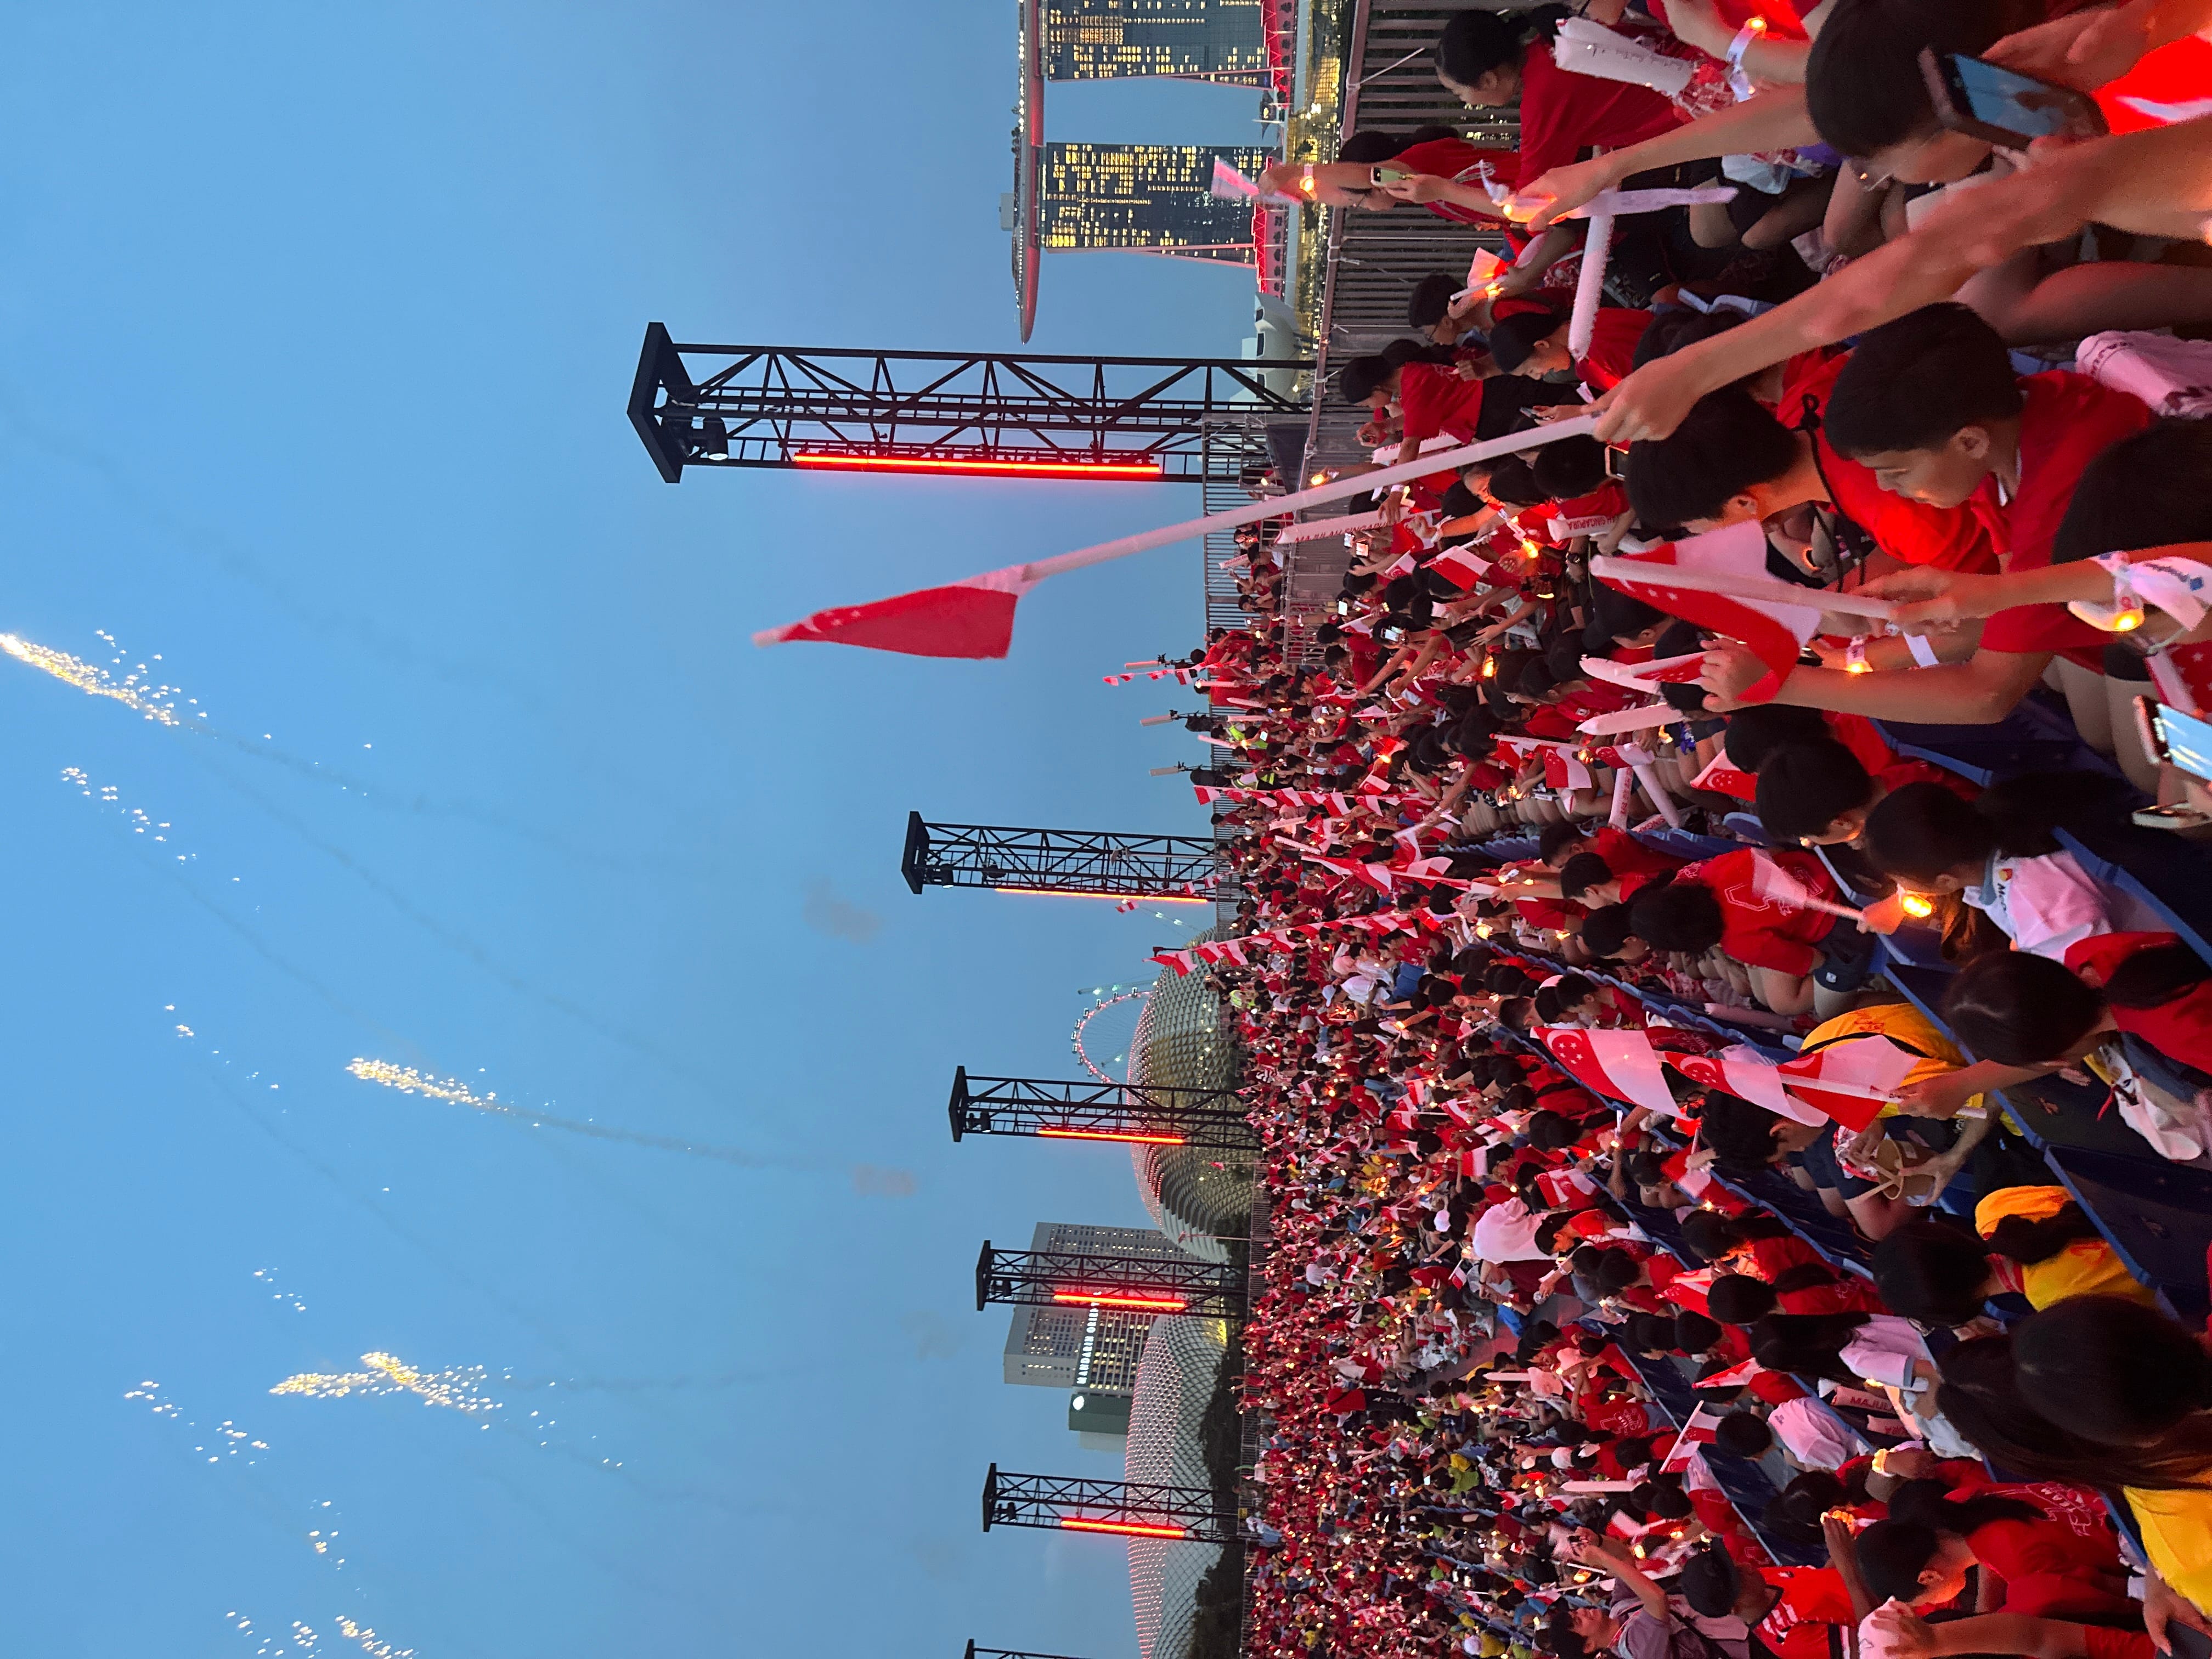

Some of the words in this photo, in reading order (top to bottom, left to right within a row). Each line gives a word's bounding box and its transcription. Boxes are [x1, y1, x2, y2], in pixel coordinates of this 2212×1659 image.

[1076, 1336, 1094, 1384] MANDARIN
[1086, 1291, 1102, 1333] ORIENTL
[2040, 1487, 2070, 1506] TEAM
